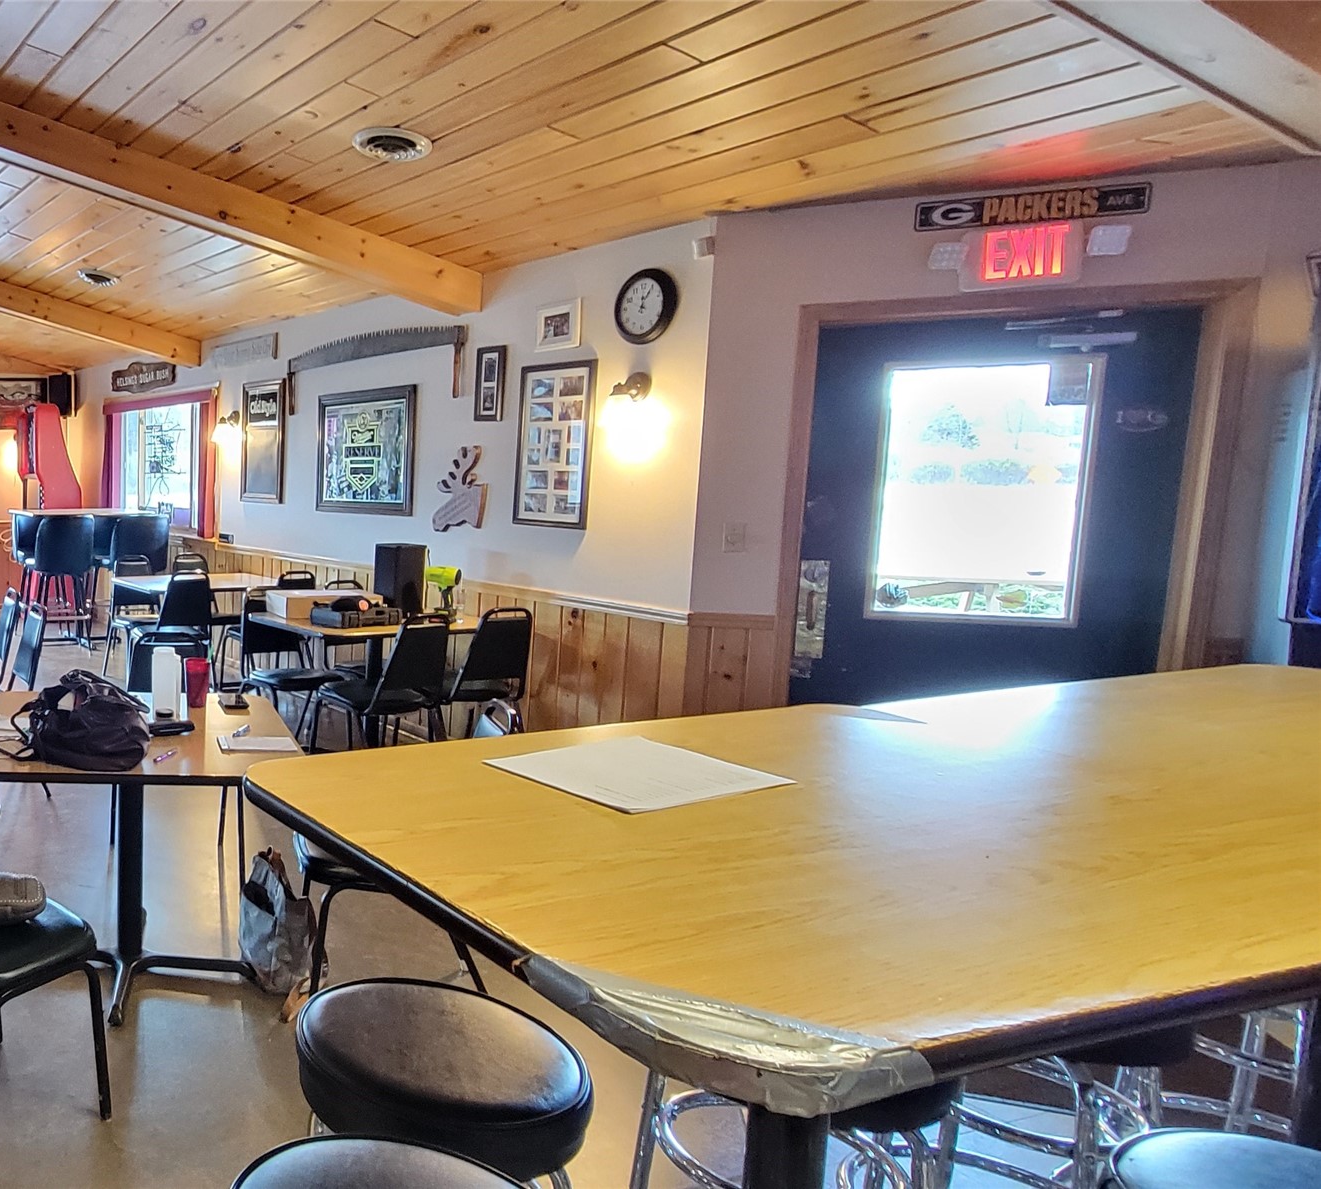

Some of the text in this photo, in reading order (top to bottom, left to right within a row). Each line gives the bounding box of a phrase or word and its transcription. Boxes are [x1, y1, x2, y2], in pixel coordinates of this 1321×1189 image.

[982, 188, 1099, 224] PACKERS
[1106, 194, 1135, 206] AVE
[983, 222, 1070, 281] EXIT
[344, 447, 381, 457] RESERVE
